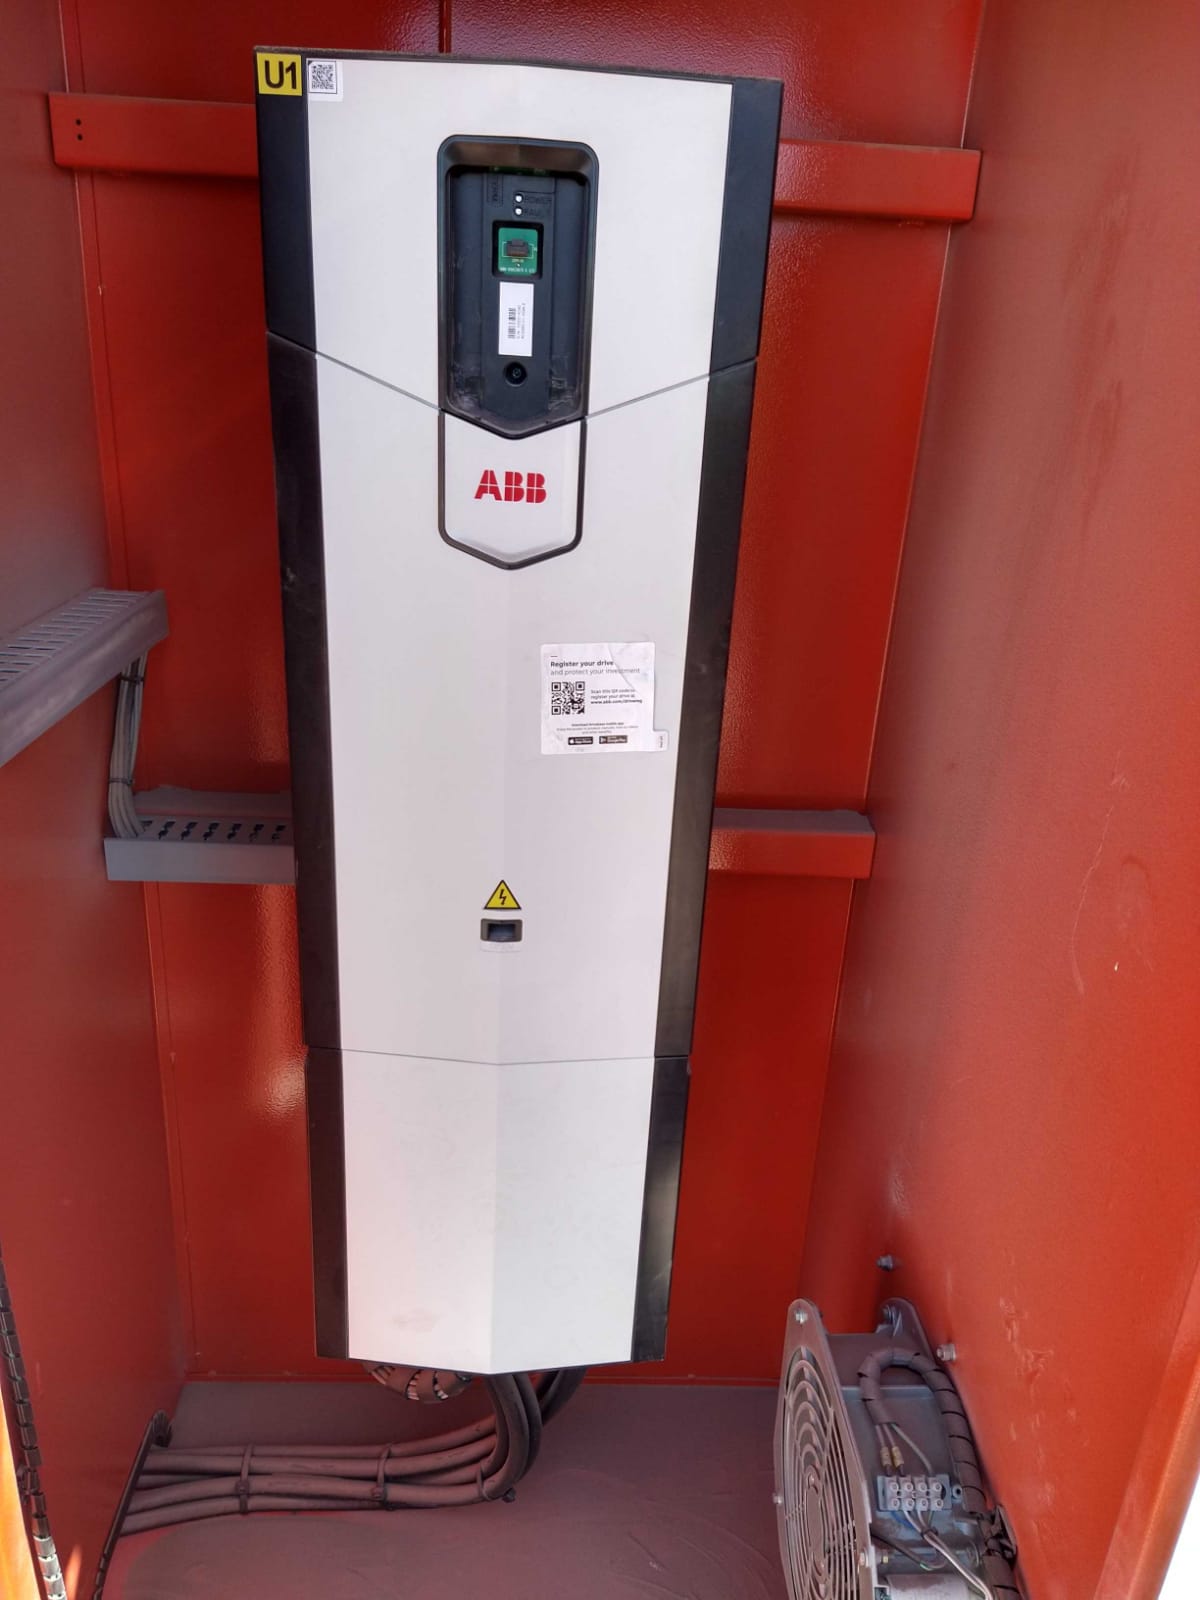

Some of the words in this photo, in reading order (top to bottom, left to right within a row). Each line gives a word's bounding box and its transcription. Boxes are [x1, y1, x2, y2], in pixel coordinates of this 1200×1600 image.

[264, 60, 297, 90] U1
[474, 469, 547, 503] ABB
[550, 661, 579, 669] Register
